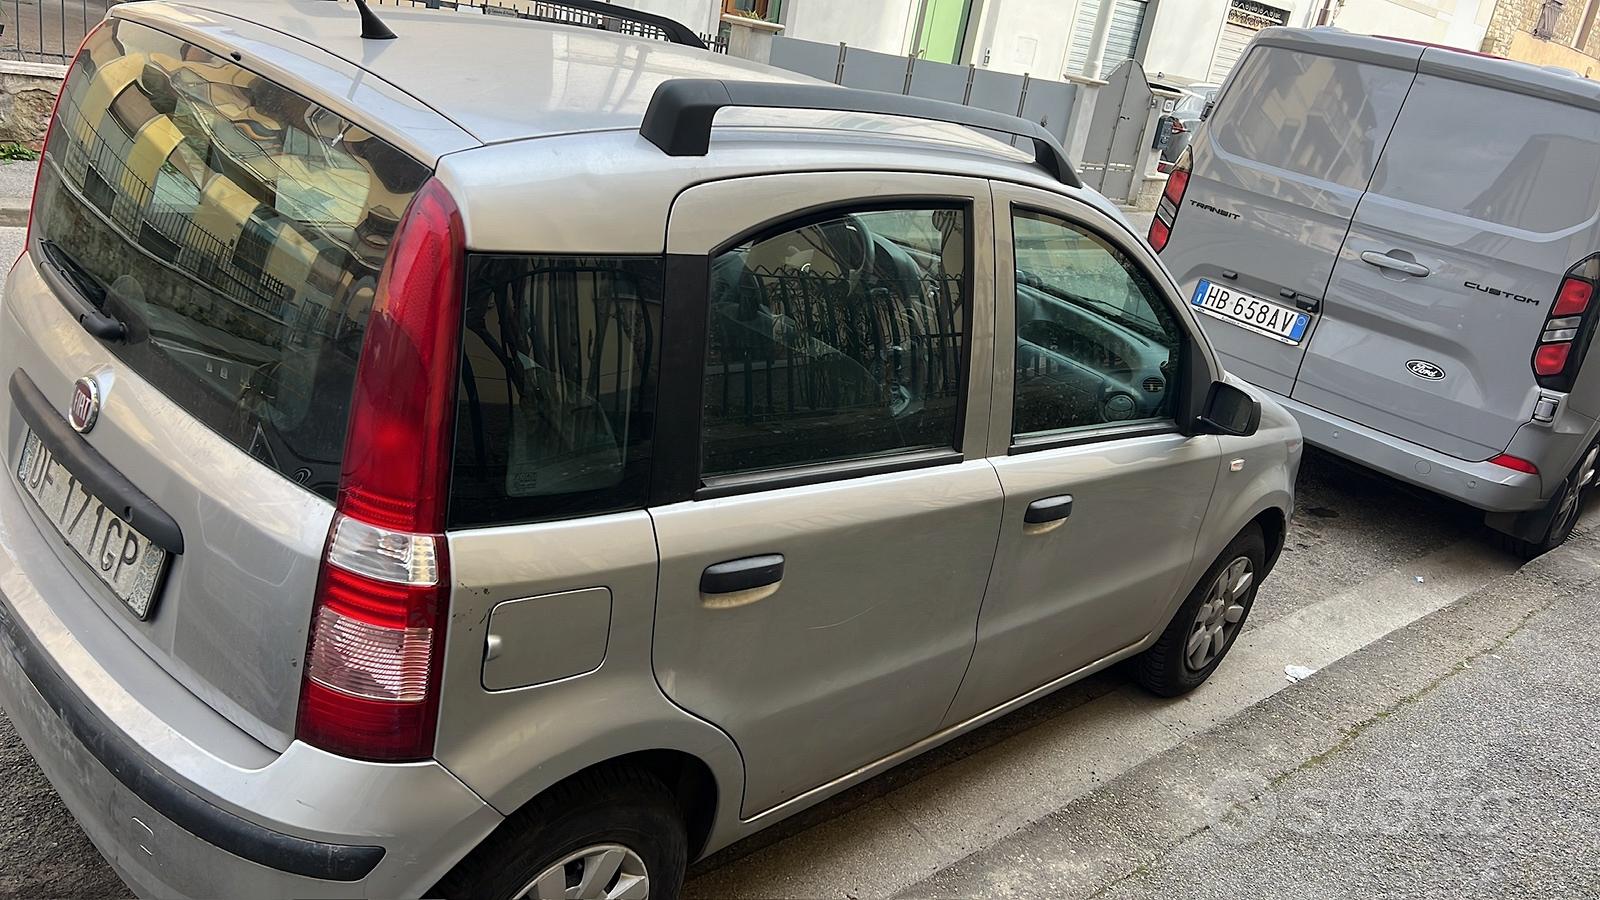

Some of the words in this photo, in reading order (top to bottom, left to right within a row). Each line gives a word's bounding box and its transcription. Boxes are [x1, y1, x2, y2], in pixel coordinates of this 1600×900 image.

[1190, 199, 1241, 220] TRANSIT
[1463, 280, 1540, 306] CUSTOM
[1204, 286, 1230, 310] HB
[1233, 297, 1295, 332] 658AV
[1412, 361, 1439, 377] Ford
[73, 388, 91, 421] FIAT
